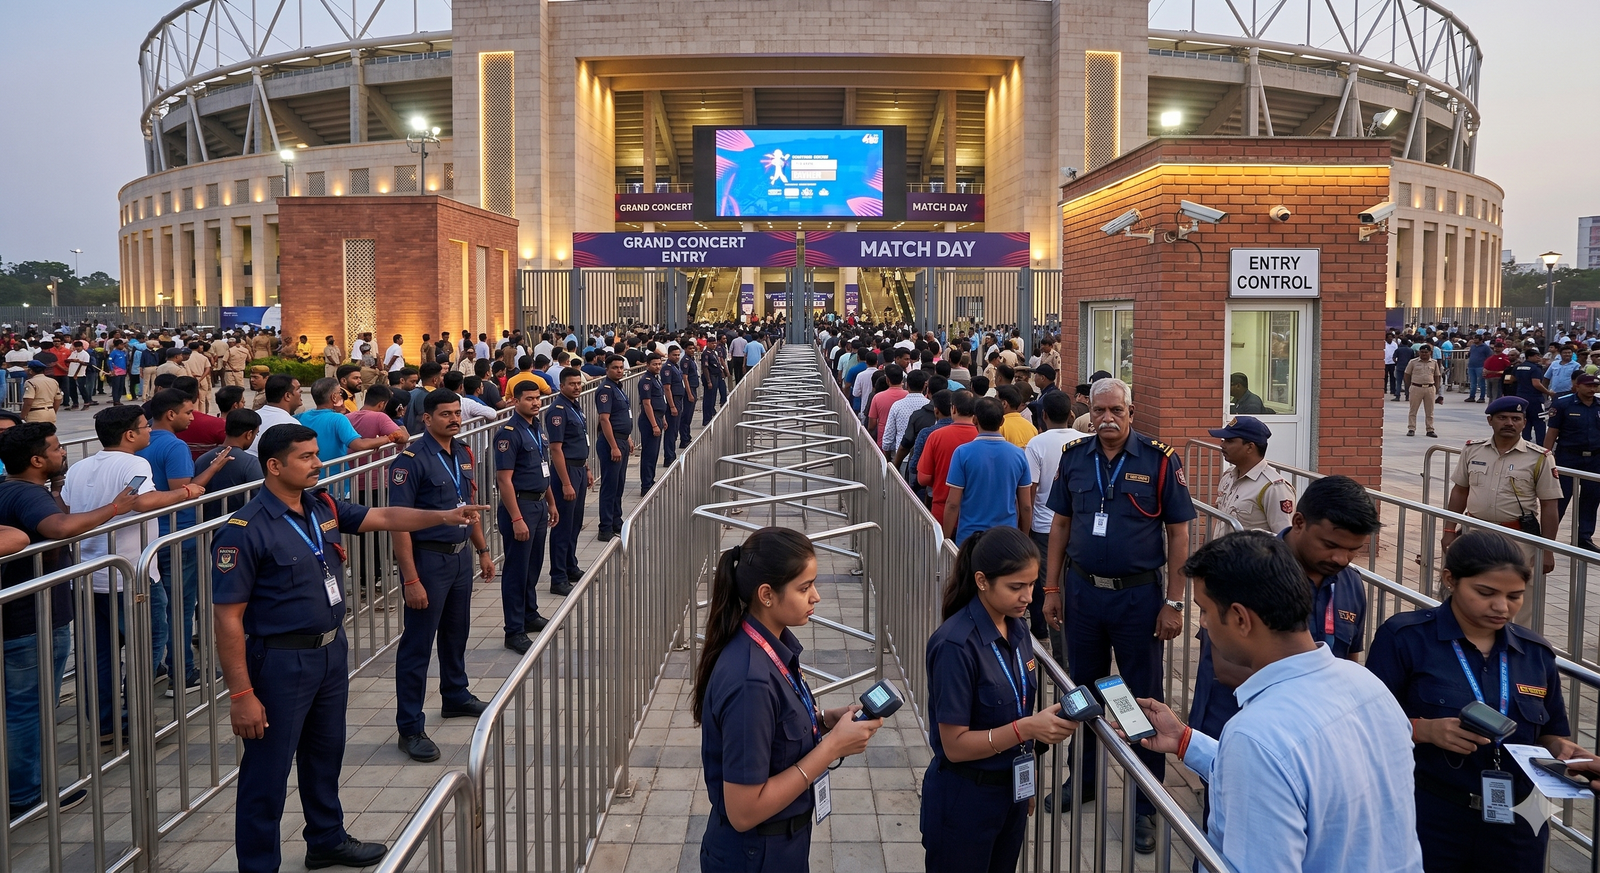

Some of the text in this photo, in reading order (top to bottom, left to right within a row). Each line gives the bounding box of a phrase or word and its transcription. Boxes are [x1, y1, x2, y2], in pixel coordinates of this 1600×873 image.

[619, 203, 693, 212] GRAND CONCERT
[912, 203, 968, 212] MATCH DAY
[623, 236, 747, 249] GRAND CONCERT
[860, 240, 977, 258] MATCH DAY
[661, 251, 708, 263] ENTRY
[1249, 256, 1301, 270] ENTRY
[1237, 275, 1313, 290] CONTROL
